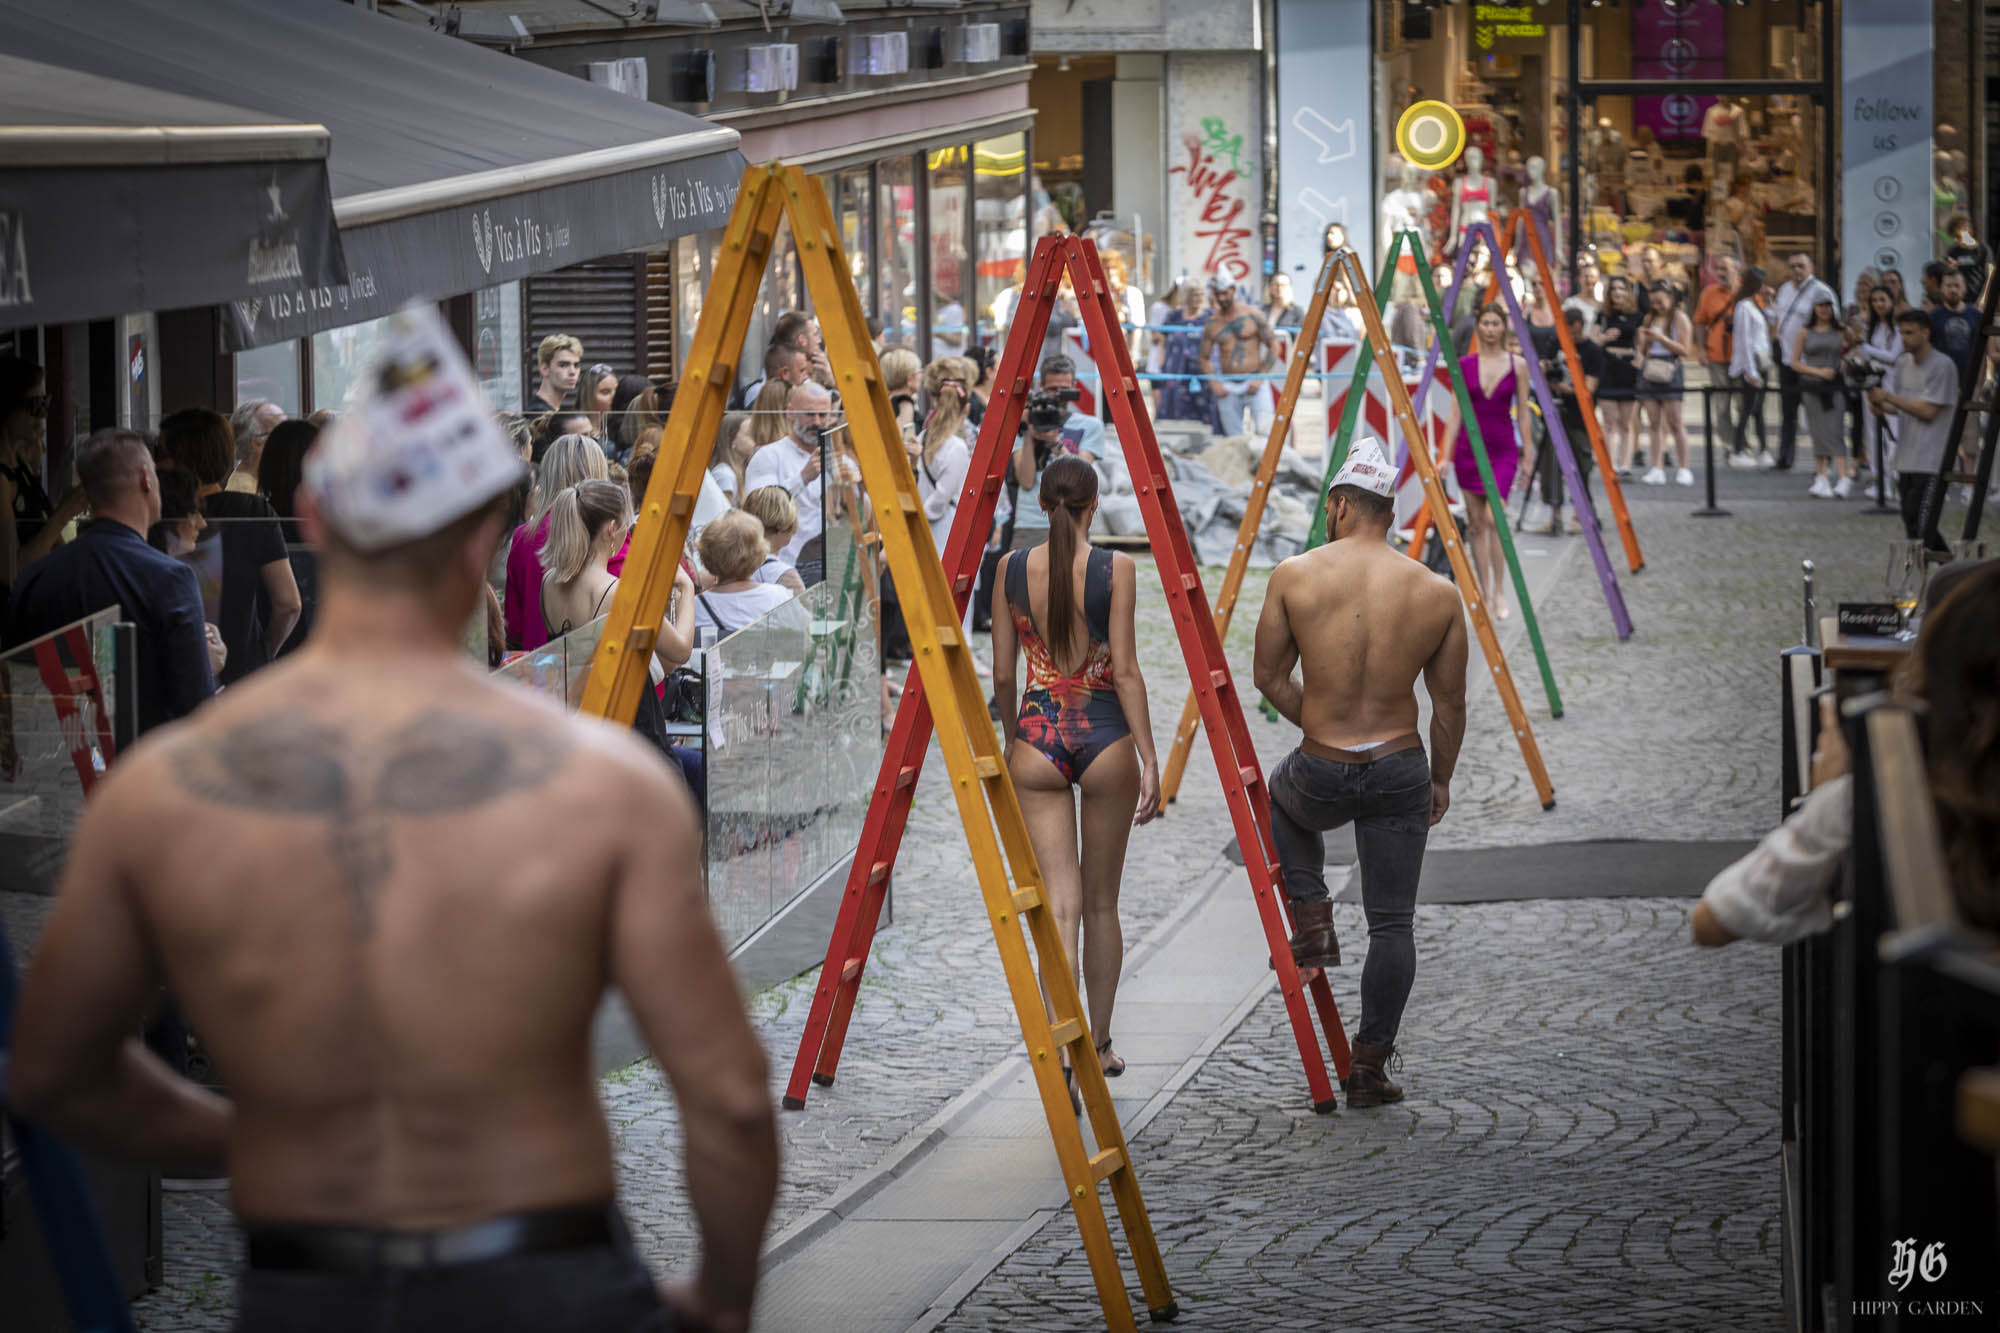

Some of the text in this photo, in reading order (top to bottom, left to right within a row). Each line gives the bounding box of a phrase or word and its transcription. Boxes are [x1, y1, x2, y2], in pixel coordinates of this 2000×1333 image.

[1854, 97, 1922, 121] follow
[1873, 134, 1897, 152] us
[714, 186, 727, 214] by
[545, 223, 553, 257] by
[1840, 609, 1899, 625] Reserved
